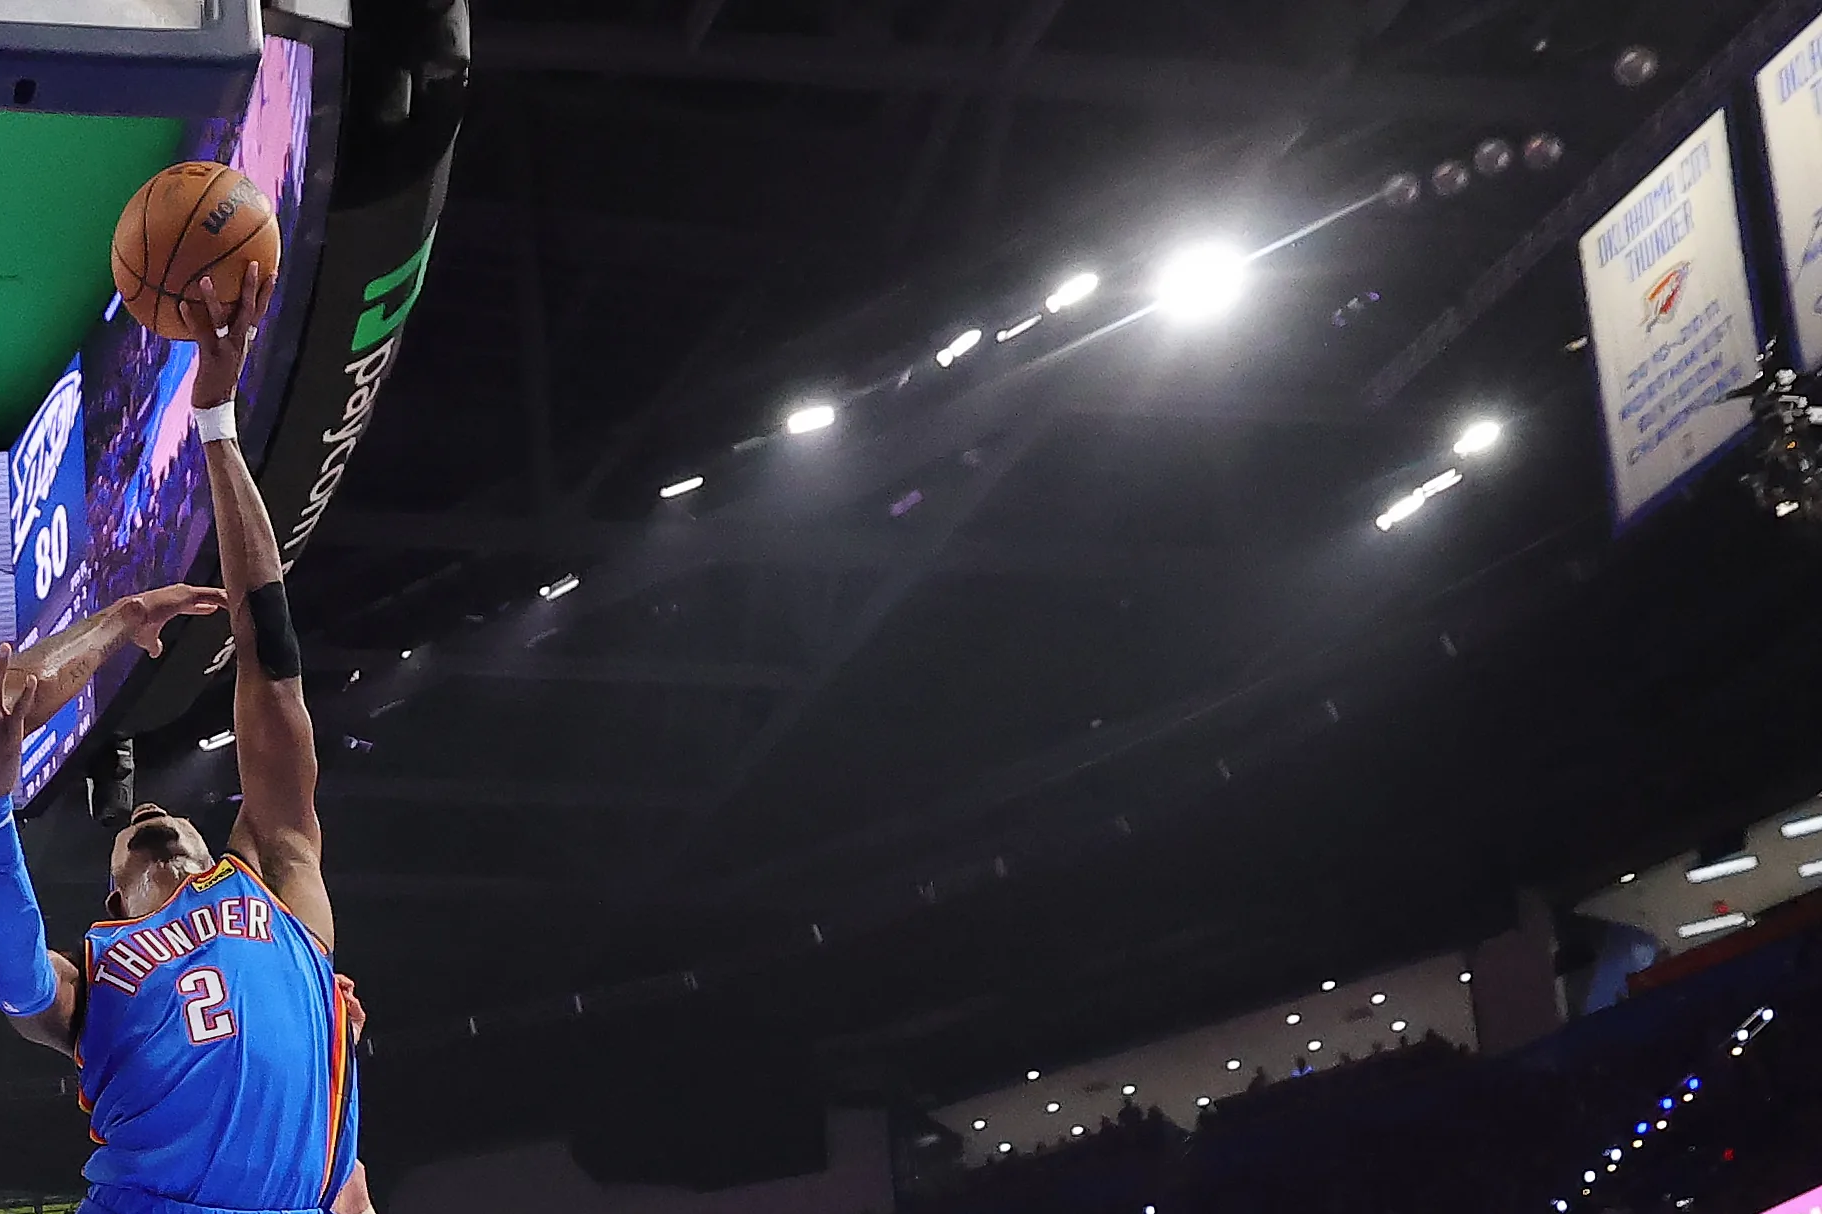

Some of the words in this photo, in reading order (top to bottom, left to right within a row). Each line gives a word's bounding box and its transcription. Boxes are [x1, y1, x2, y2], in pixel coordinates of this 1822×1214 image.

[283, 337, 397, 551] paycom
[34, 503, 69, 600] 80
[92, 897, 274, 997] THUNDER
[177, 965, 238, 1046] 2
